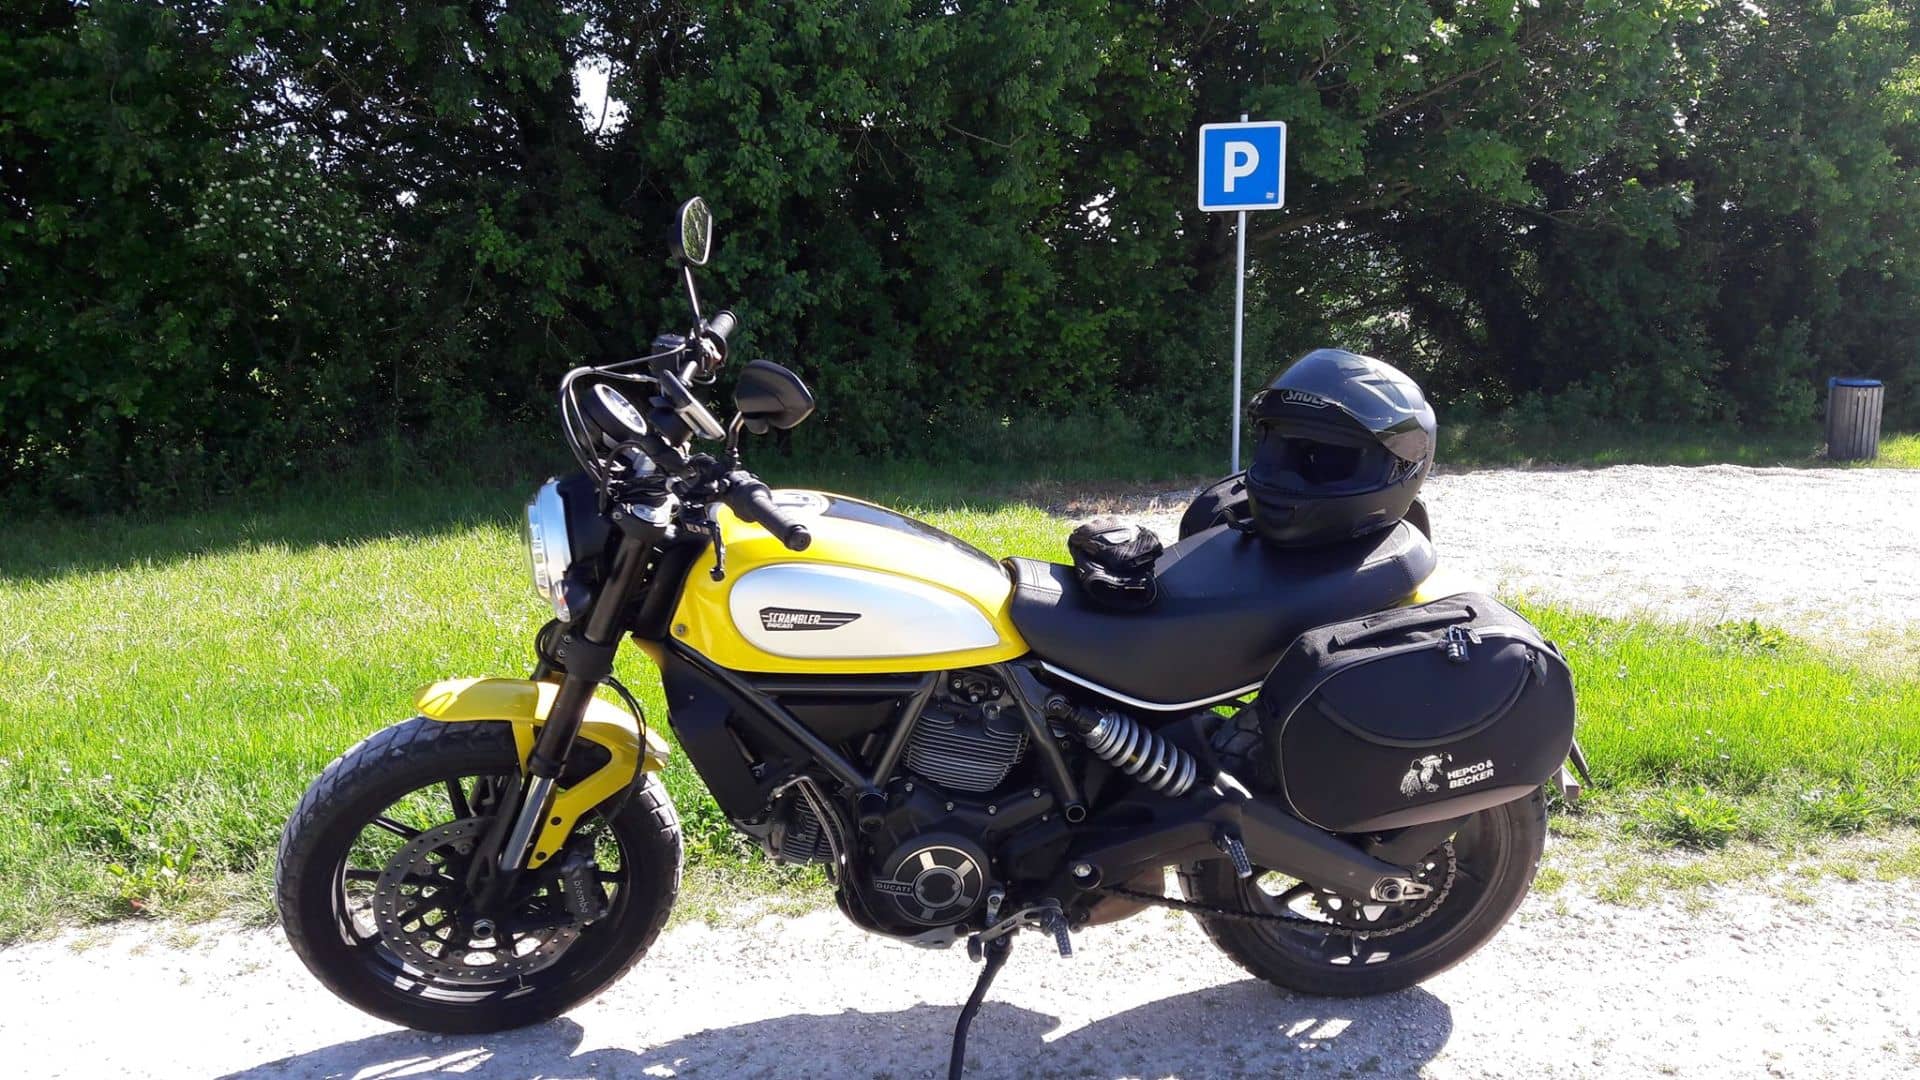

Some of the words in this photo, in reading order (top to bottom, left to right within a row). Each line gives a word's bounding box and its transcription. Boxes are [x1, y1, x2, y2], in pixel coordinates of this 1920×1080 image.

[1223, 141, 1260, 193] P
[768, 612, 821, 625] SCRAMBLER
[1447, 762, 1485, 780] HEPCO
[1486, 759, 1494, 769] &
[1449, 768, 1495, 789] BECKER
[876, 882, 911, 893] DUCATI
